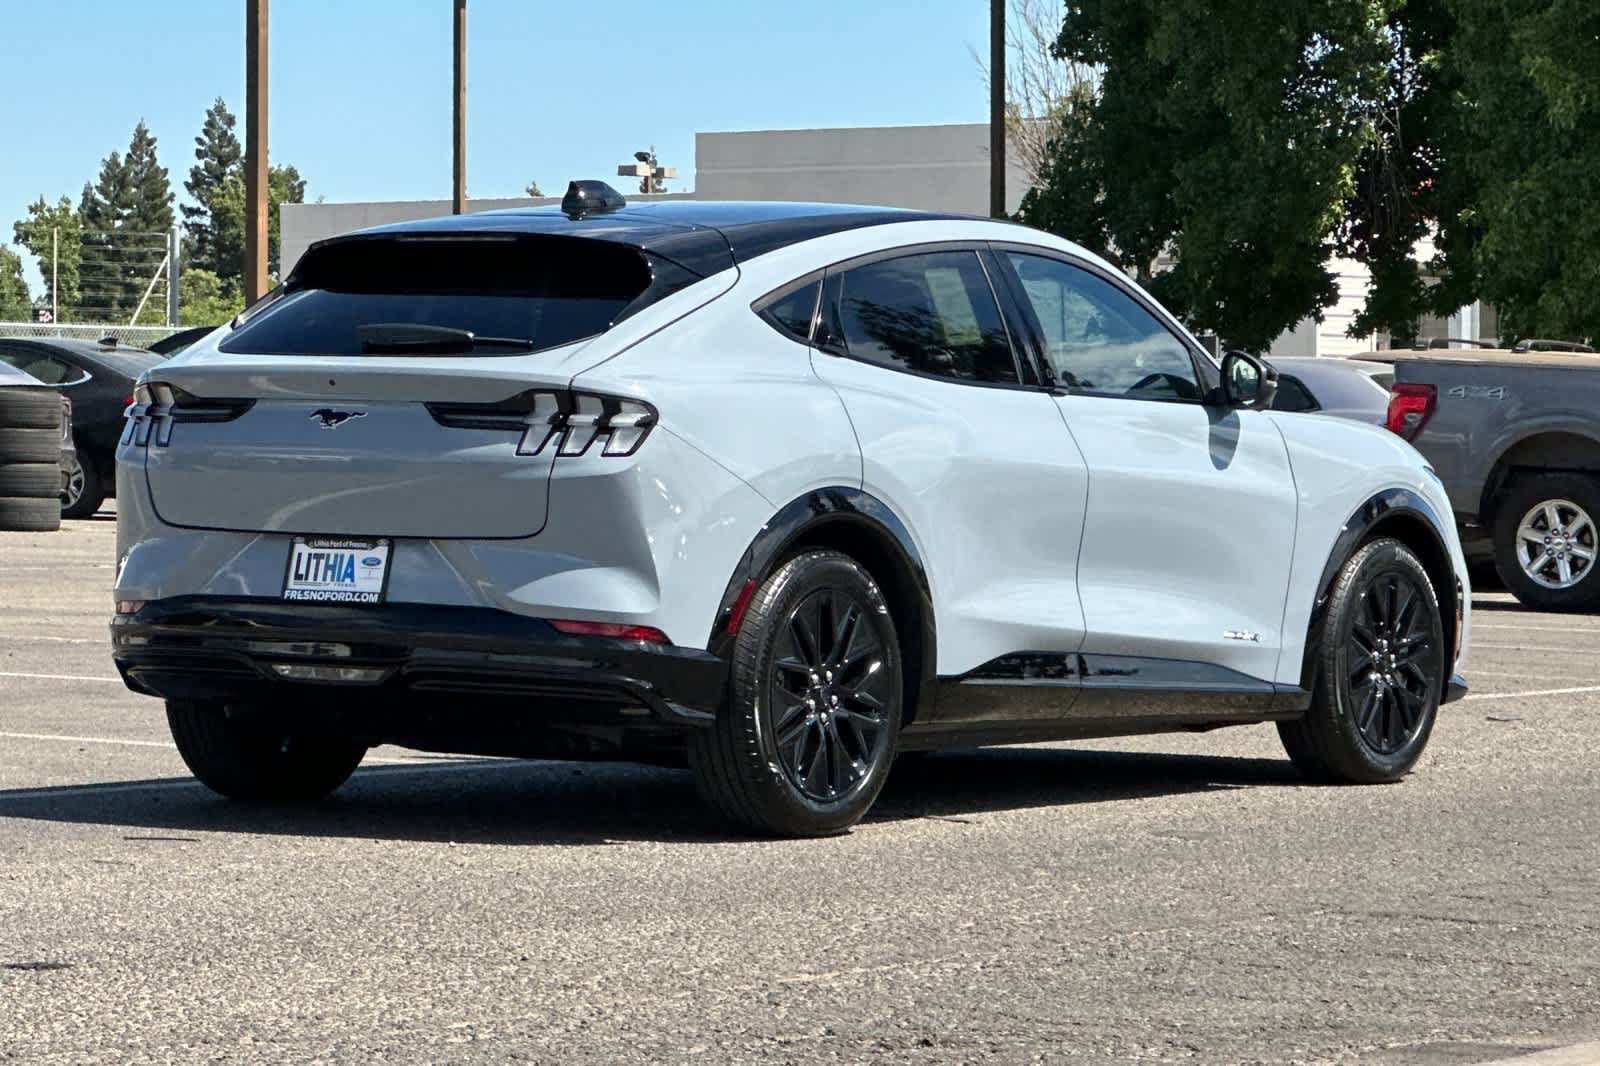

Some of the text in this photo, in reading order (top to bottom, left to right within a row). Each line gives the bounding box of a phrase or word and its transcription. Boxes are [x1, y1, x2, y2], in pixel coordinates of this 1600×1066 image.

[1448, 385, 1503, 400] 44
[293, 552, 355, 583] LITHIA
[283, 590, 379, 603] FRESNOFORD.COM
